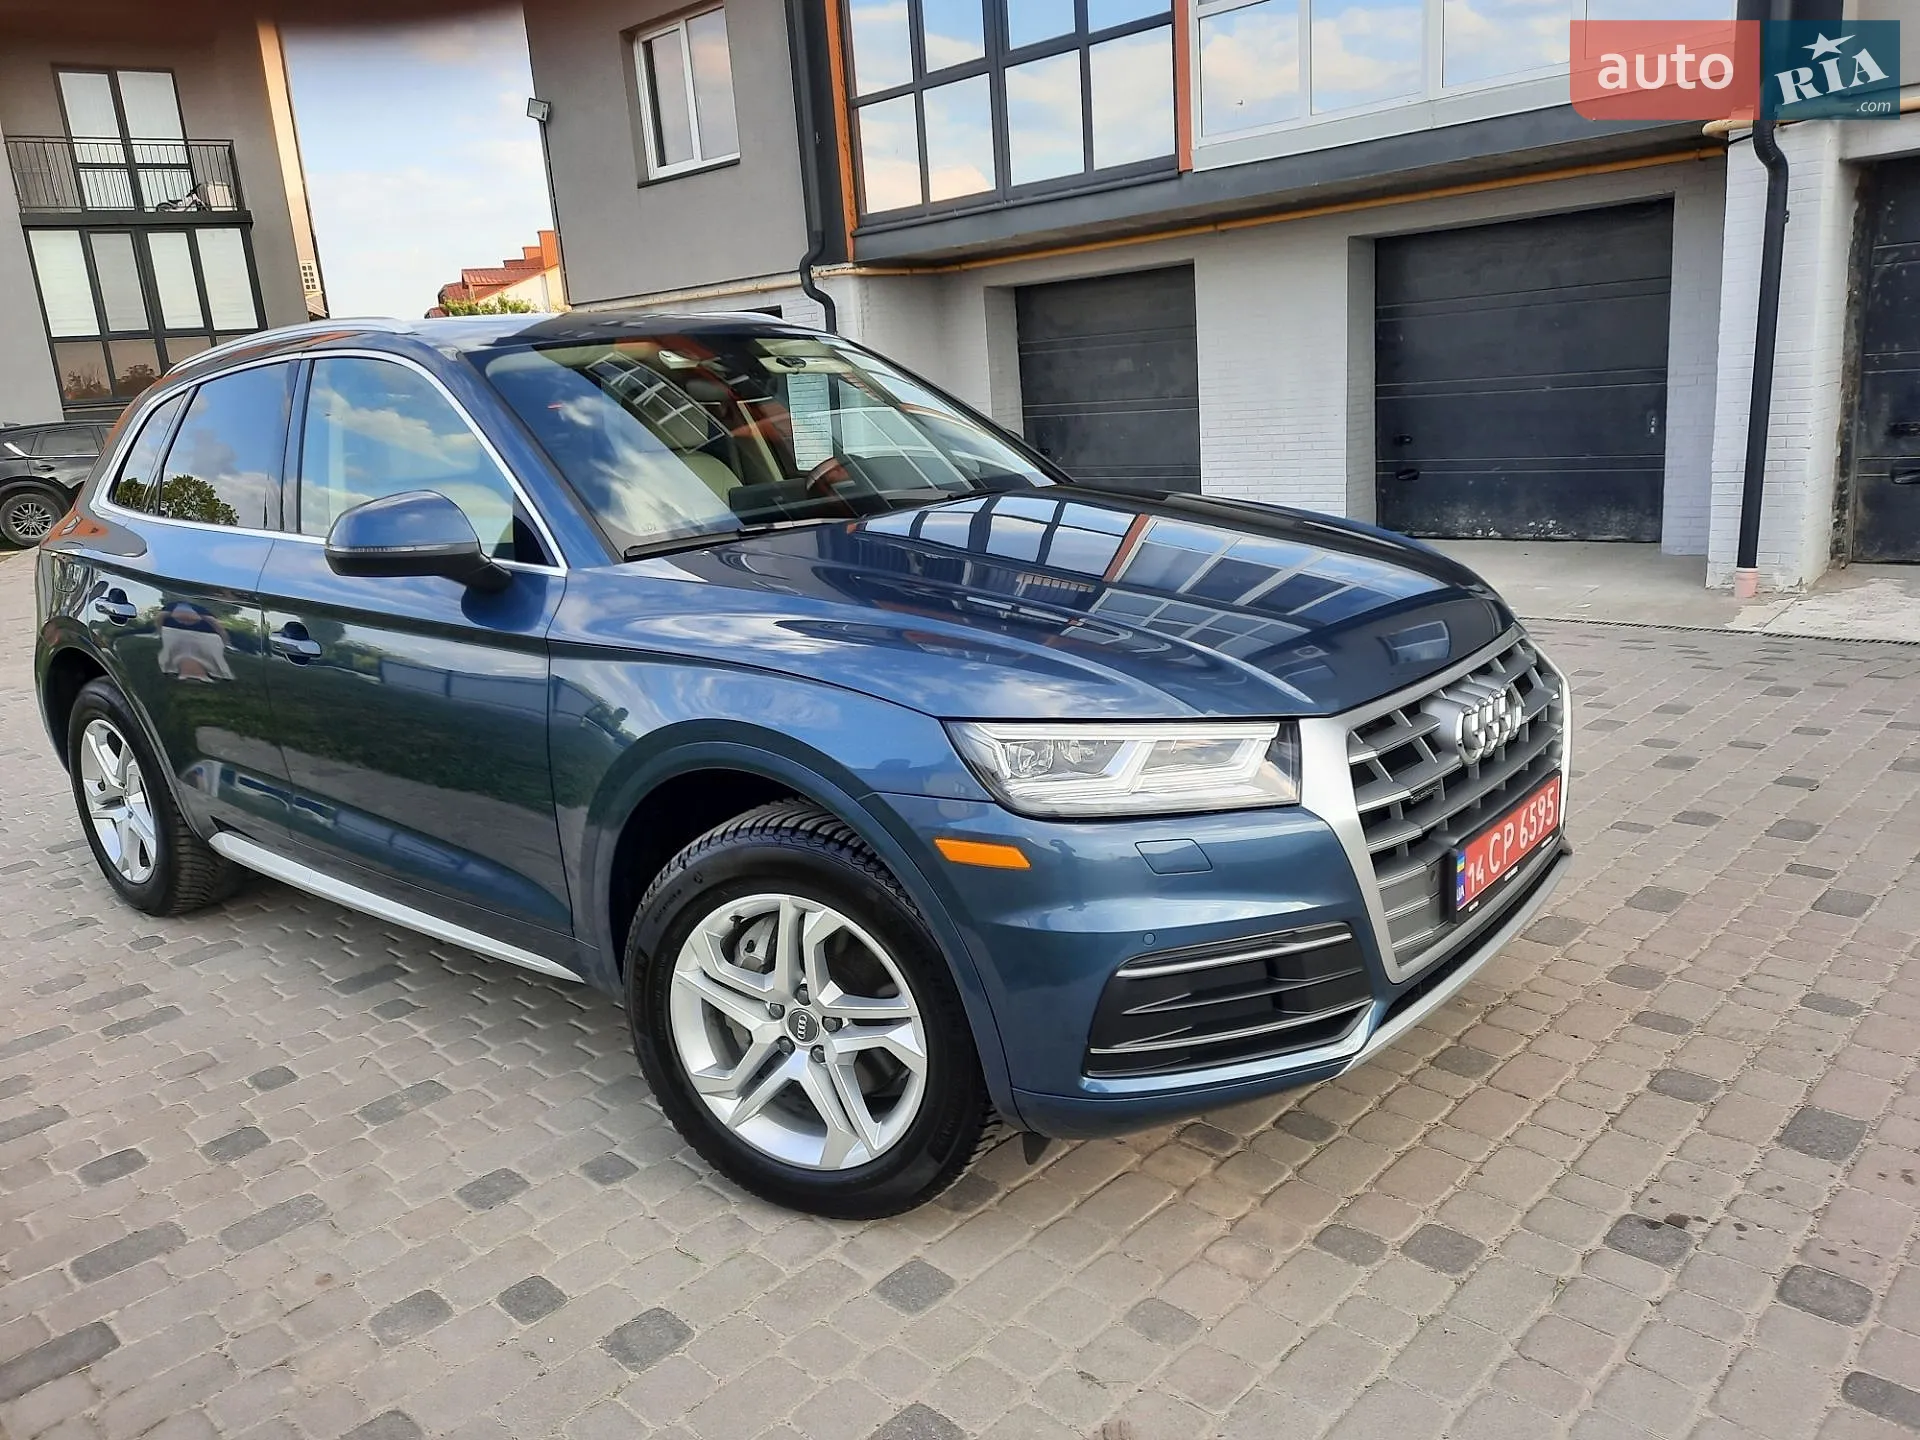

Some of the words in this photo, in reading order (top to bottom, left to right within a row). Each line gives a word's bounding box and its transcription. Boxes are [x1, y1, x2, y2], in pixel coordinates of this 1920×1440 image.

[1467, 854, 1485, 893] 14
[1489, 822, 1515, 874] CP
[1520, 786, 1554, 849] 6595
[1456, 884, 1465, 902] UA
